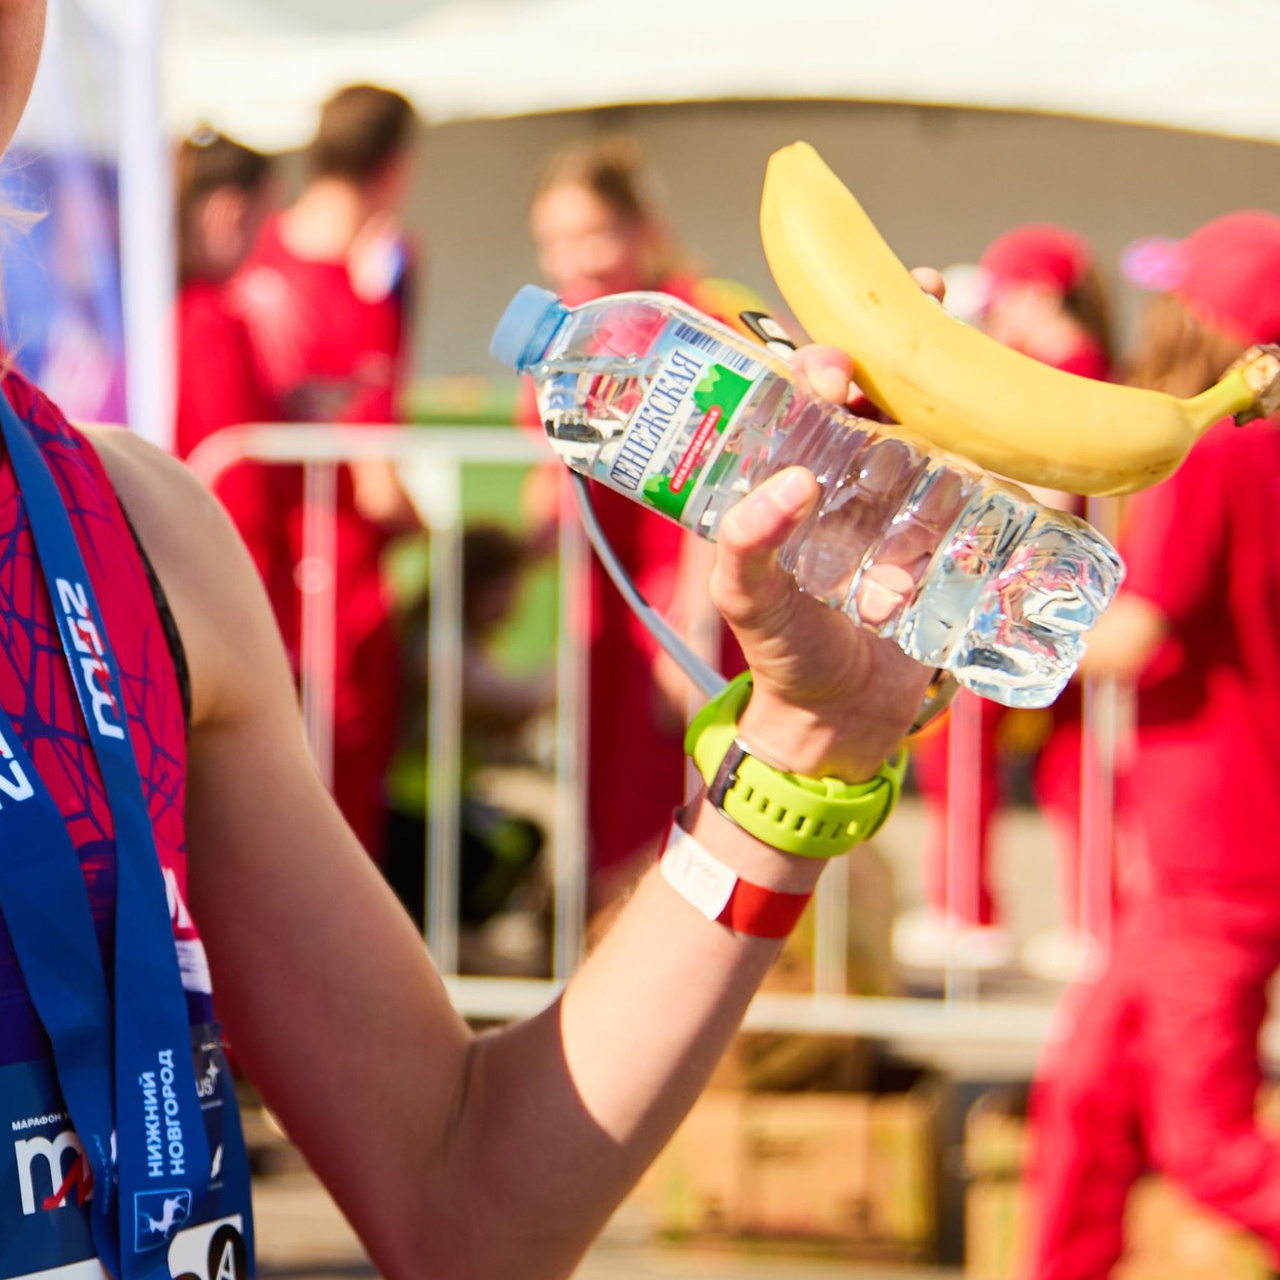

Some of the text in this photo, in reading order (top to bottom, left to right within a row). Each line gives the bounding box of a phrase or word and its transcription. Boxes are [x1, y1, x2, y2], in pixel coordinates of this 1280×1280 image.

[609, 349, 704, 492] СЕНЕЖСКАЯ
[671, 408, 721, 491] НЕГАЗИРОВАННАЯ
[11, 1113, 62, 1132] МАРАФОН
[138, 1071, 164, 1178] НИЖНИЙ
[158, 1048, 186, 1176] НОВГОРОД
